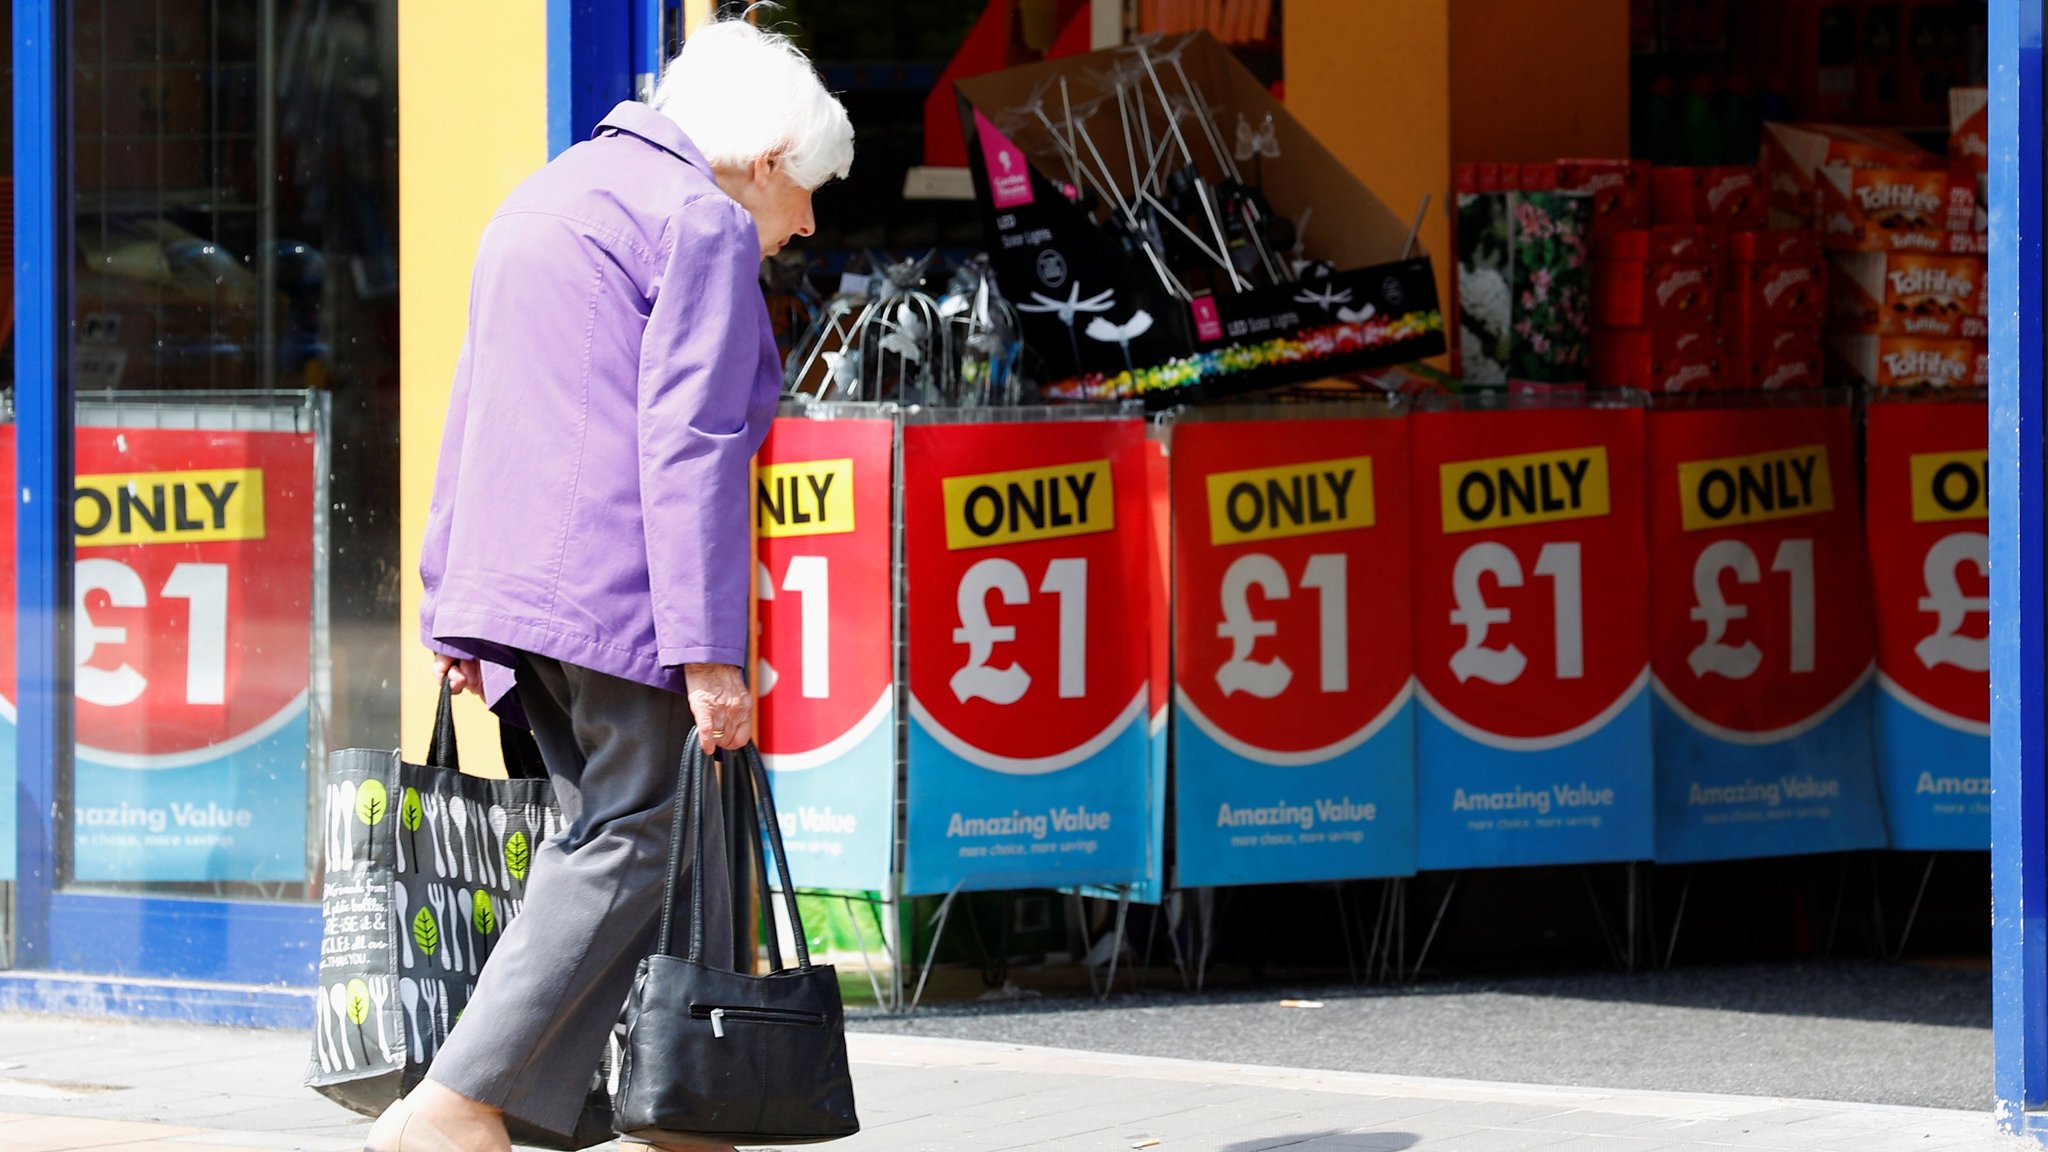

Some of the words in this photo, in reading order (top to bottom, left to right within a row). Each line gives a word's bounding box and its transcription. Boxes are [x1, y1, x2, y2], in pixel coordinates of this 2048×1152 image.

[997, 213, 1017, 231] LED
[1227, 319, 1248, 337] LED
[75, 481, 238, 537] ONLY
[758, 473, 835, 526] NLY
[963, 472, 1096, 537] ONLY
[1226, 469, 1356, 533] ONLY
[1457, 458, 1591, 522] ONLY
[1697, 455, 1817, 520] ONLY
[1932, 461, 1988, 512] O
[75, 558, 228, 706] £1
[949, 557, 1087, 705] £1
[1215, 553, 1348, 699] £1
[1448, 541, 1584, 685] £1
[1687, 538, 1815, 680] £1
[170, 801, 252, 827] Value
[1216, 799, 1314, 829] Amazing
[1315, 795, 1377, 822] Value
[1452, 785, 1550, 815] Amazing
[1551, 781, 1615, 807] Value
[1688, 778, 1781, 807] Amazing
[1780, 772, 1840, 798] Value
[797, 806, 857, 834] Value
[946, 810, 1046, 839] Amazing
[1049, 805, 1112, 831] Value
[959, 844, 987, 857] more
[1030, 841, 1057, 853] more
[373, 912, 386, 931] &
